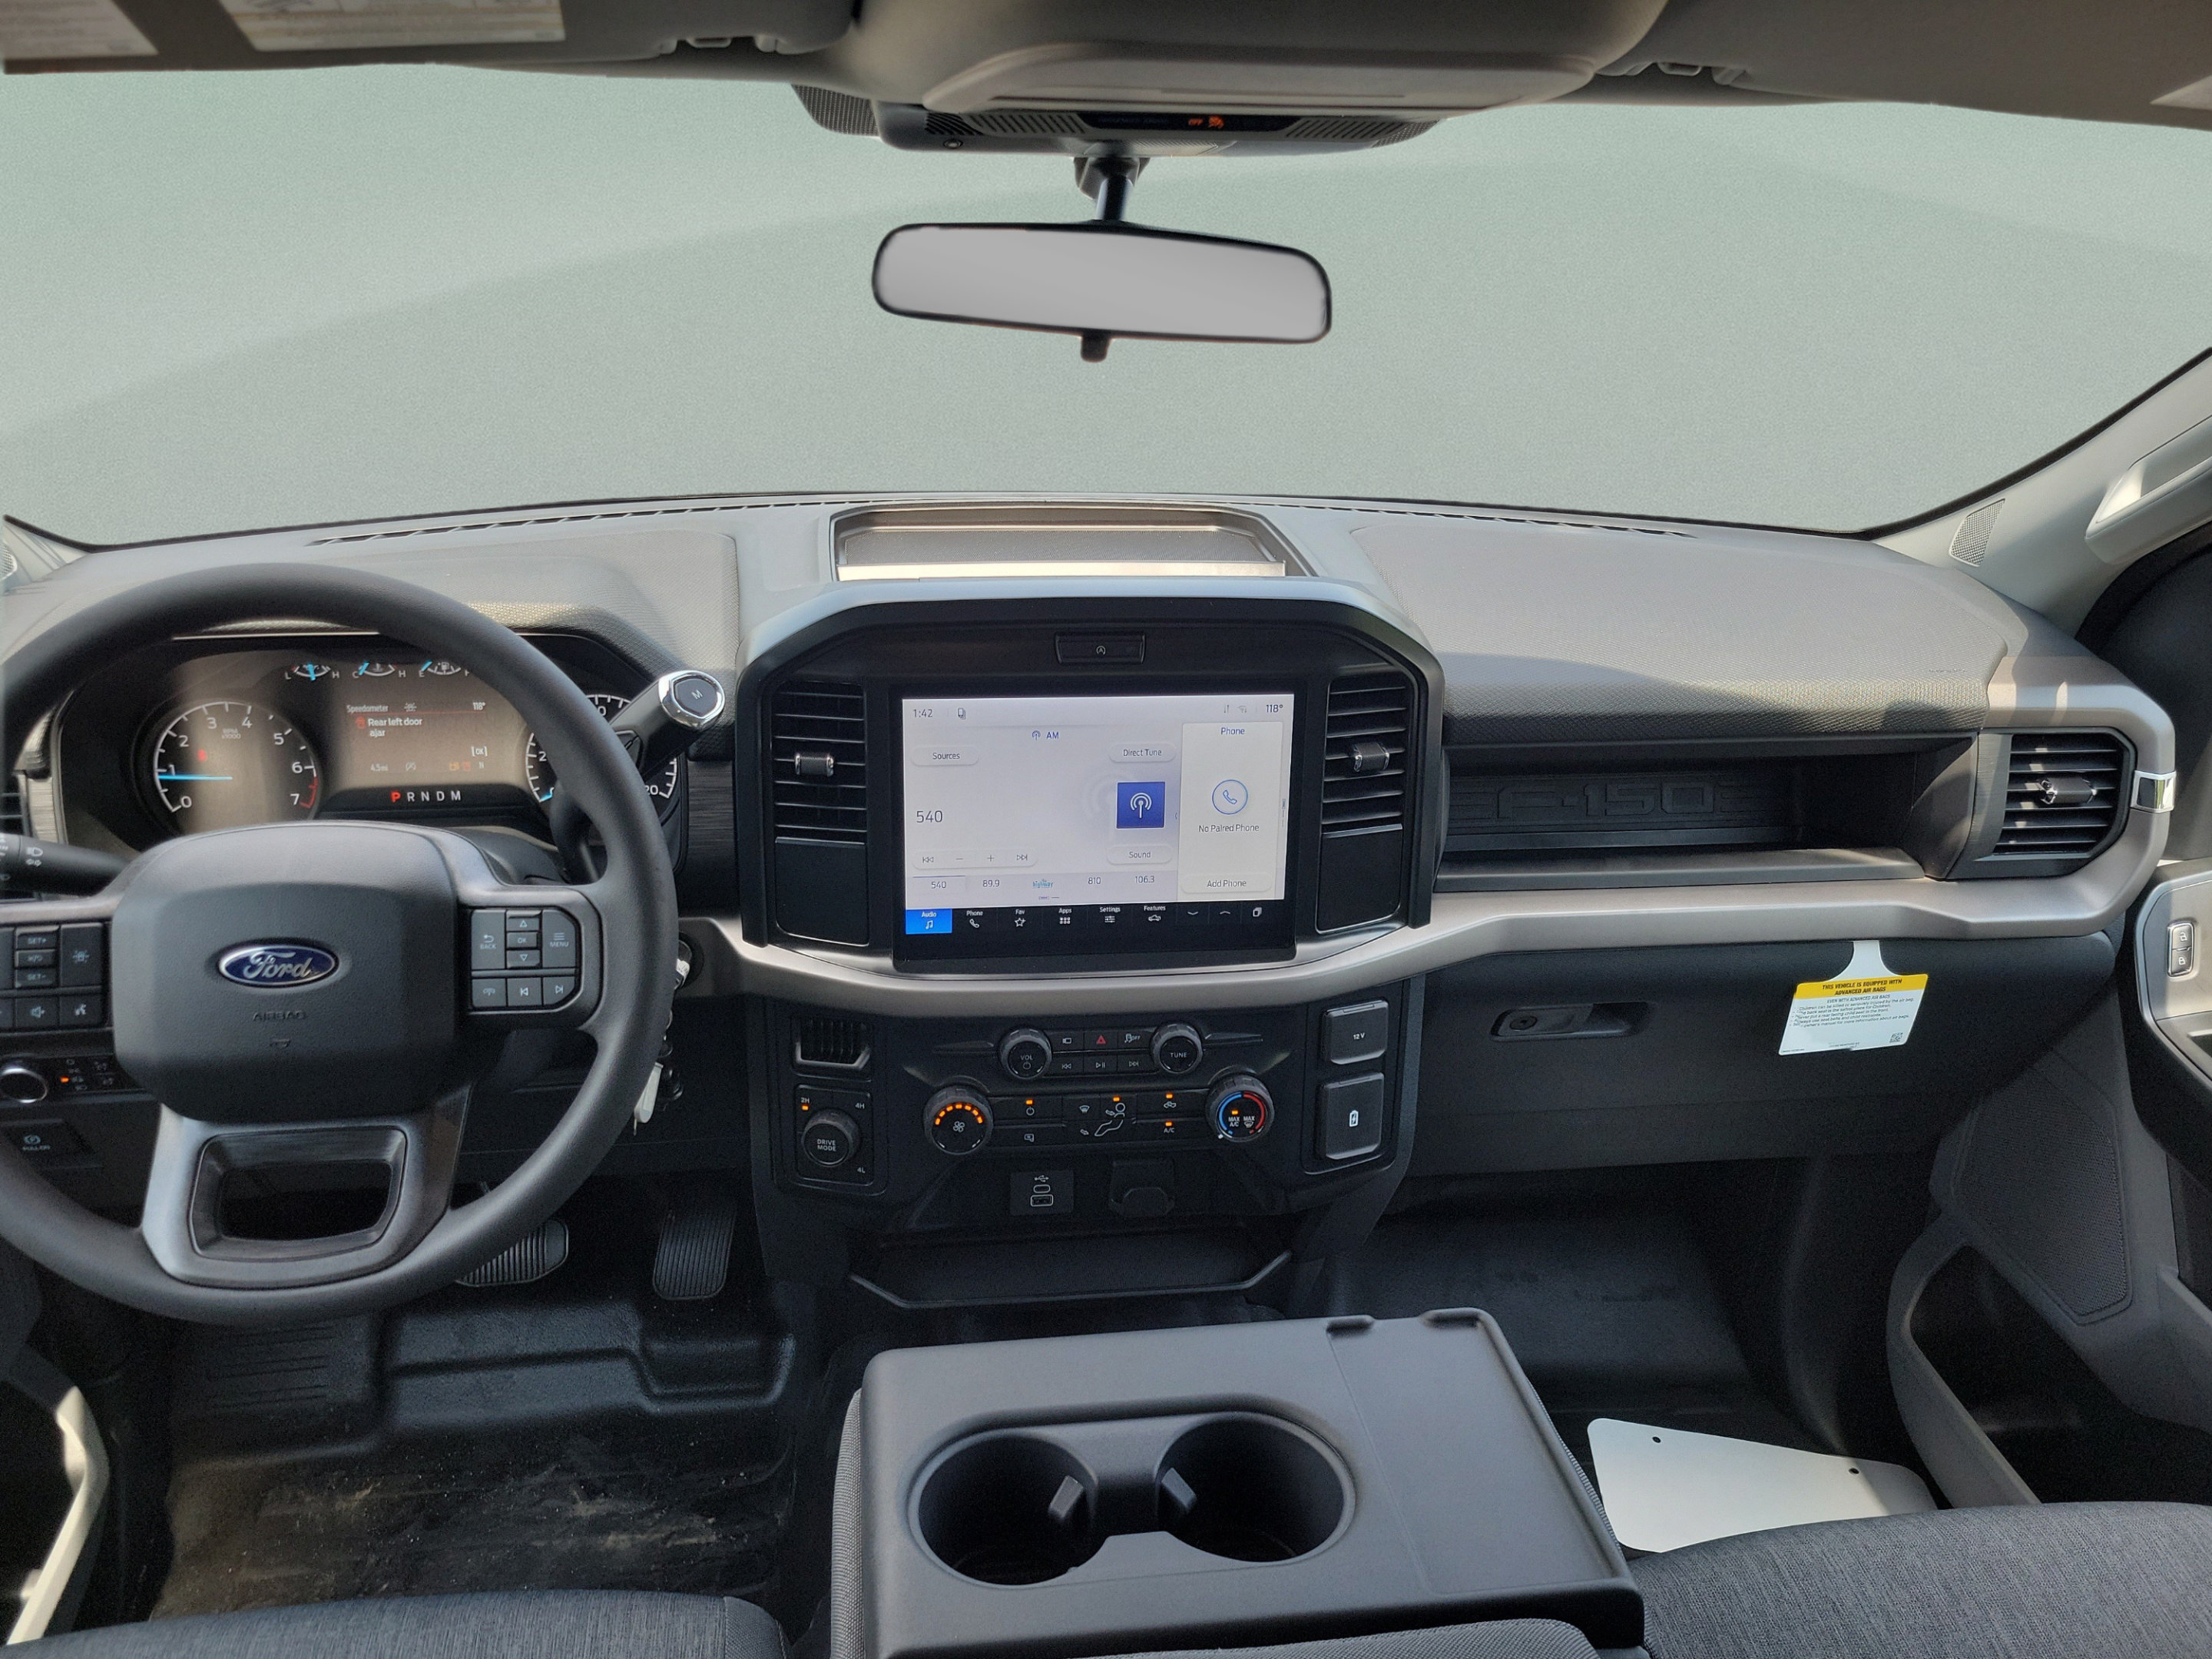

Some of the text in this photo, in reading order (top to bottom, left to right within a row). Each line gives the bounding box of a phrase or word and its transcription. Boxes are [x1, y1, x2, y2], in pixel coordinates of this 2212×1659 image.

[691, 689, 703, 700] M
[346, 704, 389, 713] Speedometer
[912, 708, 933, 718] 1:42
[1266, 704, 1283, 713] 118°
[207, 717, 217, 729] 3
[242, 717, 253, 728] 4
[368, 717, 422, 727] Rear left door
[369, 729, 386, 738] ajar
[1046, 731, 1059, 740] AM
[1220, 727, 1245, 735] Phone
[179, 735, 189, 747] 2
[273, 733, 284, 745] 5
[292, 761, 303, 773] 6
[290, 793, 300, 805] 7
[390, 790, 462, 803] P R N D M
[1497, 781, 1714, 818] F-150
[180, 796, 192, 808] 0
[916, 810, 943, 823] 540
[1210, 824, 1234, 833] Paired
[1236, 823, 1260, 832] Phone
[982, 879, 1000, 888] 89.9
[1088, 876, 1101, 885] 810
[1135, 876, 1155, 884] 106.3
[1223, 879, 1247, 887] Phone
[243, 950, 312, 979] Ford
